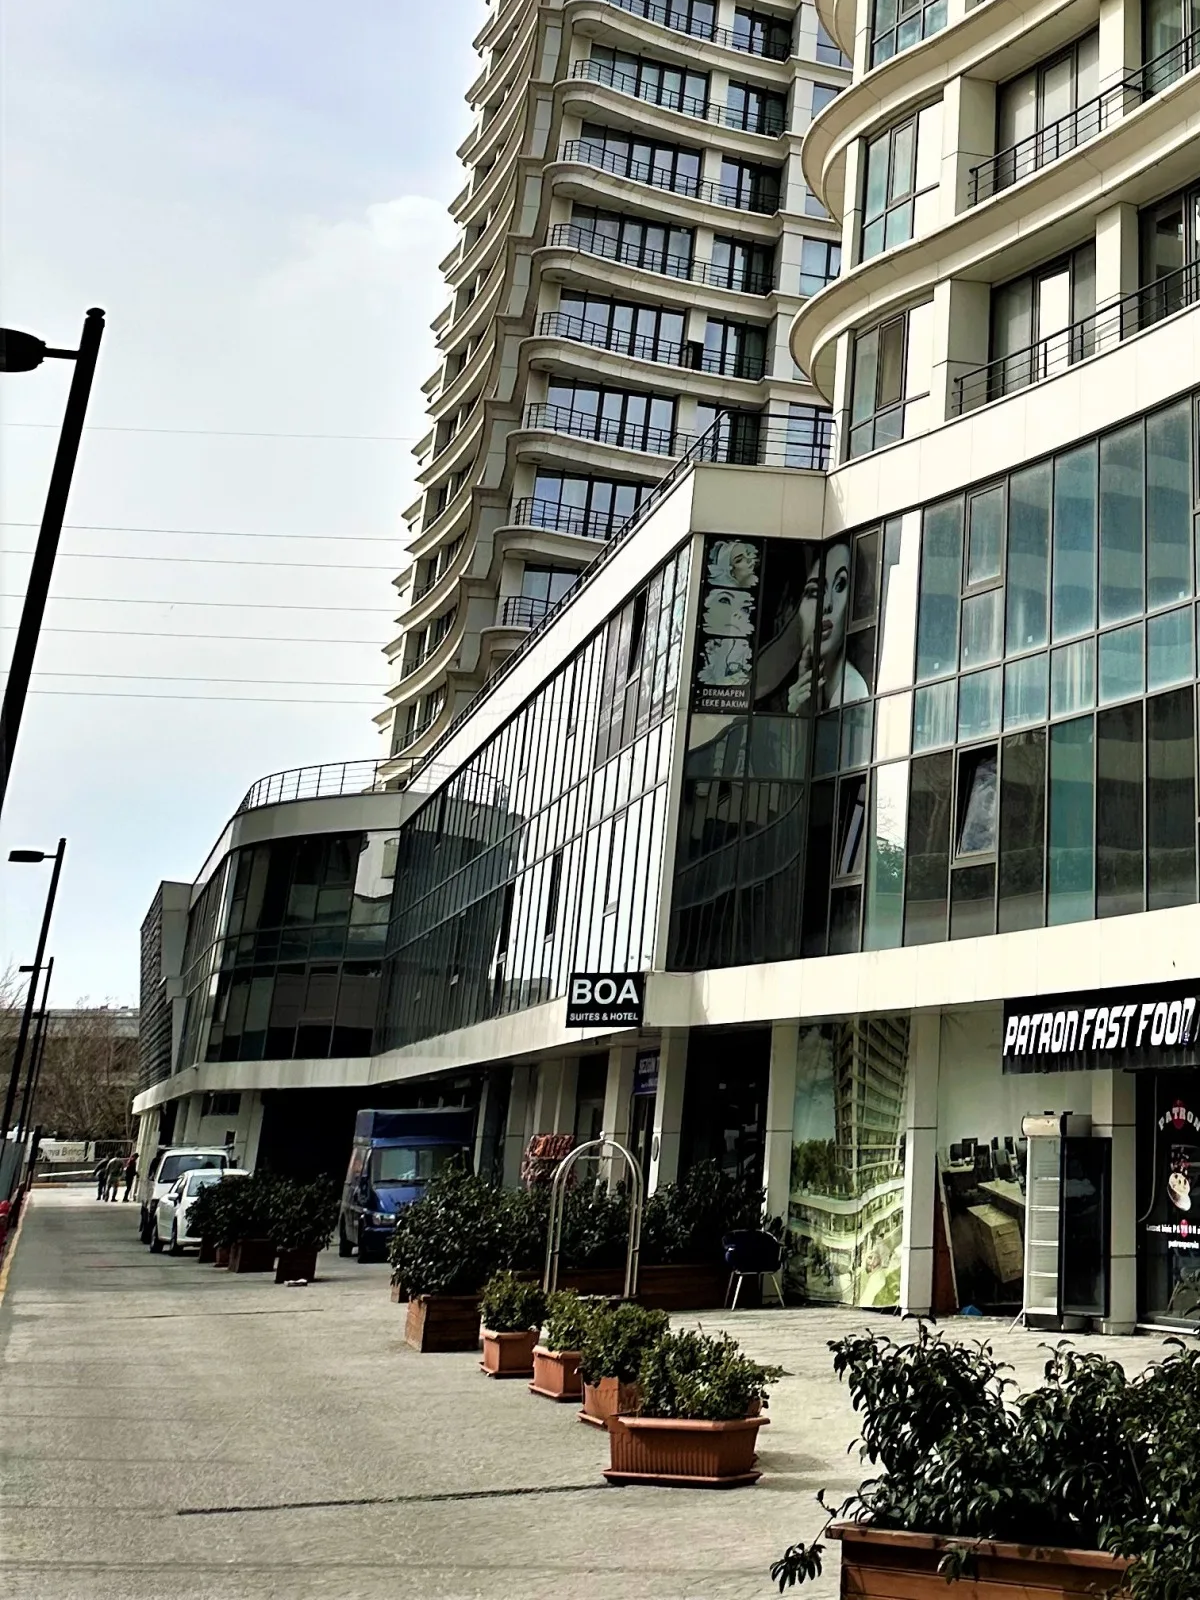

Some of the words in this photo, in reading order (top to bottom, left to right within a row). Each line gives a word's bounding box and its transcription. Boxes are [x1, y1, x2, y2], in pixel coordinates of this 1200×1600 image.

[702, 688, 745, 698] DERMAPEN
[701, 699, 719, 707] LEKE
[571, 978, 639, 1004] BOA
[569, 1012, 600, 1021] SUITES
[601, 1012, 608, 1021] &
[609, 1012, 639, 1021] HOTEL
[1003, 1010, 1079, 1056] PATRON
[1079, 1004, 1138, 1051] FAST
